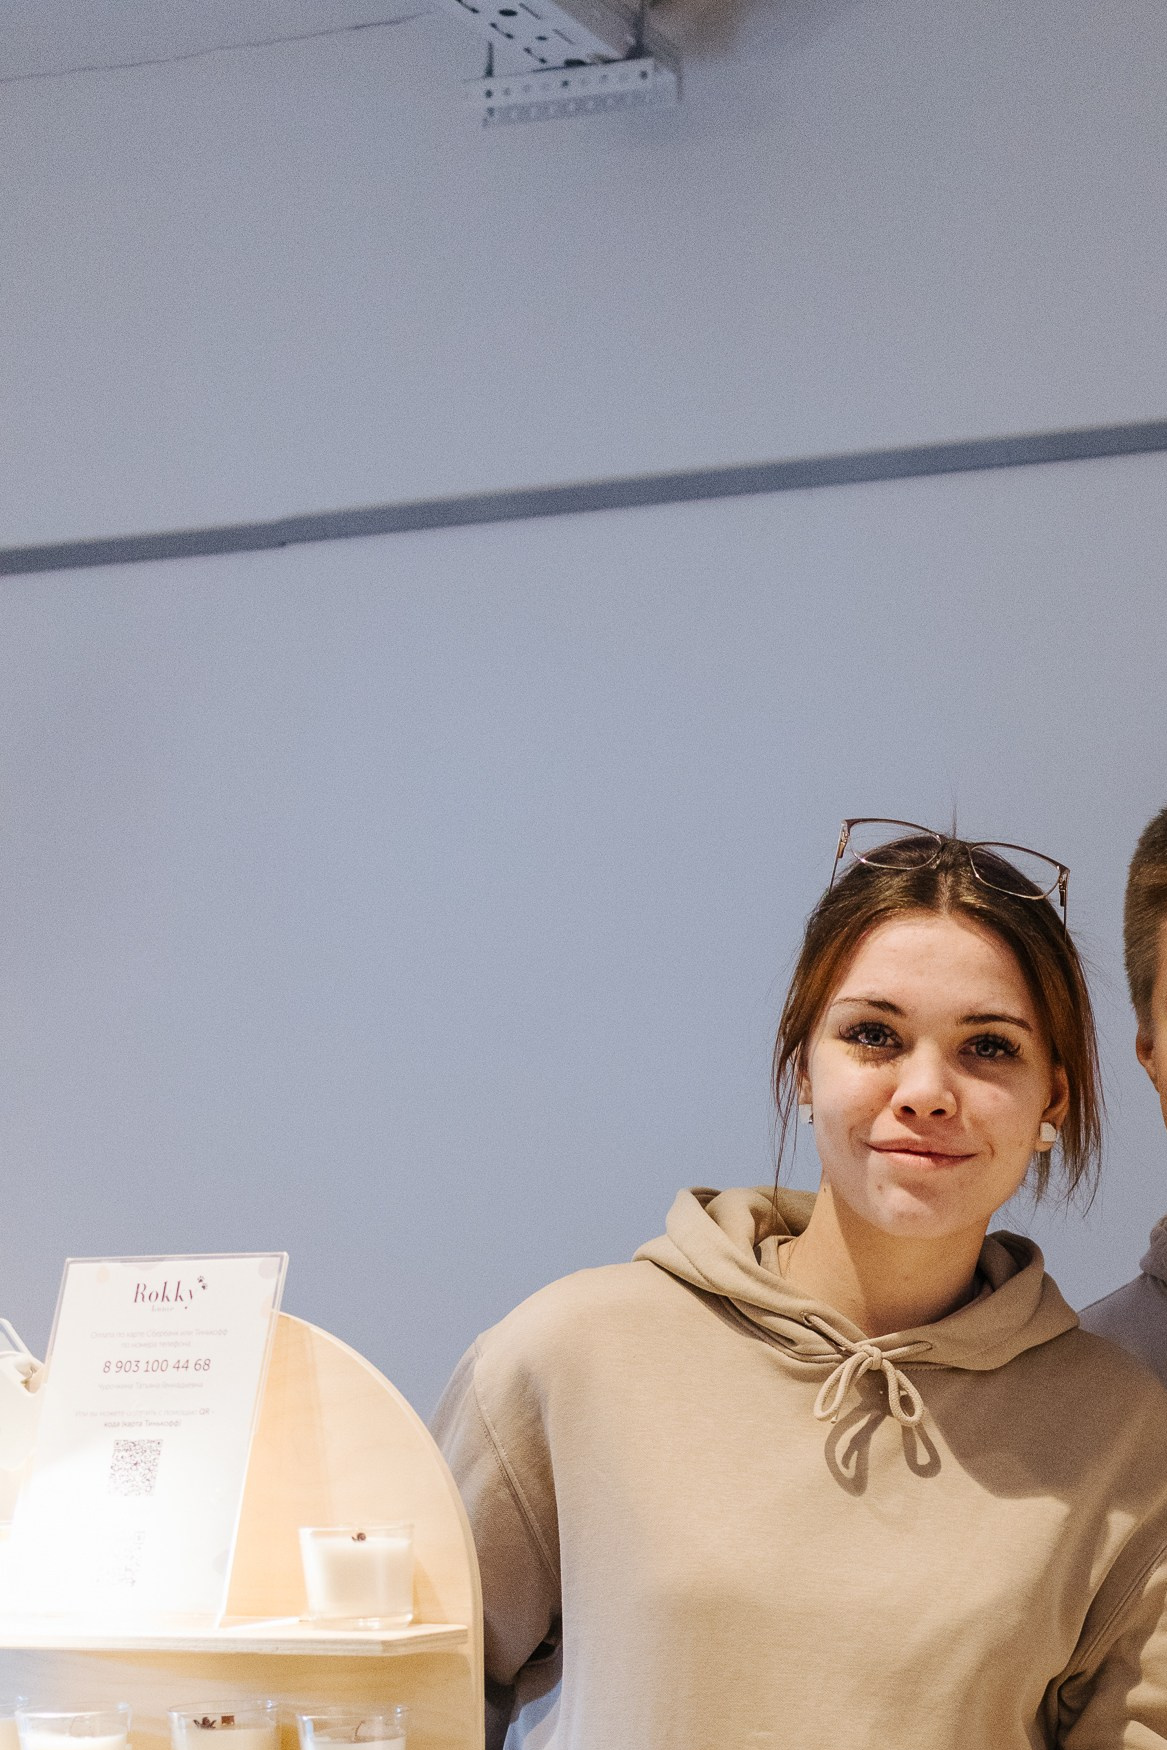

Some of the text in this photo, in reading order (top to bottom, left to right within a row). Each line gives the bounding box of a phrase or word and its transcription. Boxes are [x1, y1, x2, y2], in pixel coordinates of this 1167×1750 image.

[134, 1280, 195, 1310] Rokky
[103, 1358, 211, 1373] 8 903 100 44 68
